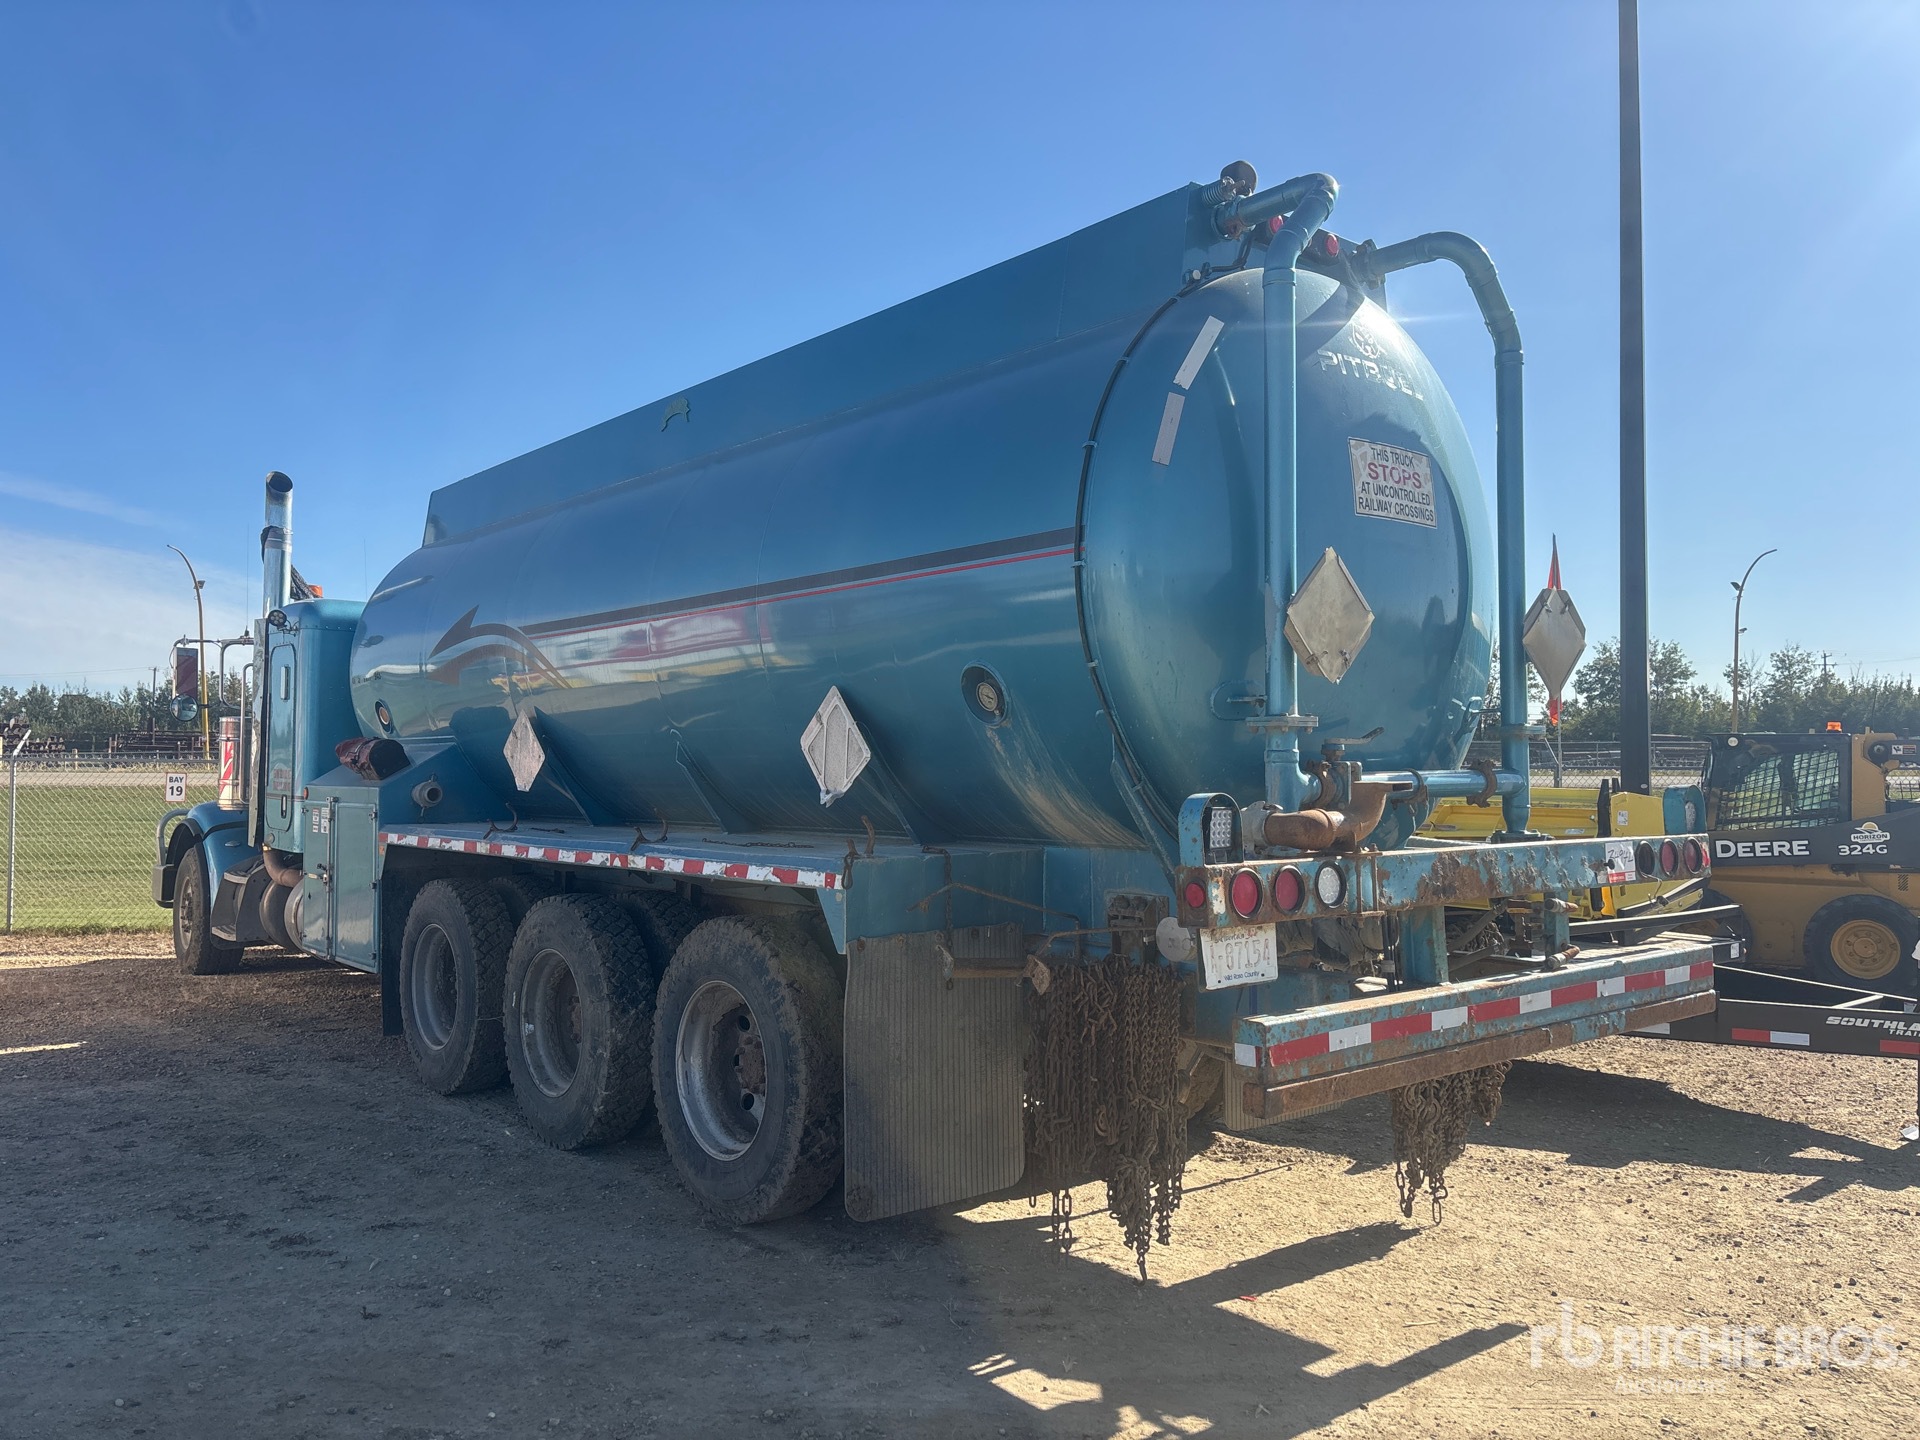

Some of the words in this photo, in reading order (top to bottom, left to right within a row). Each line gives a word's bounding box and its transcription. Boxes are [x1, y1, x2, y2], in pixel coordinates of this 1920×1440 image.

[1371, 447, 1389, 462] THIS
[1390, 451, 1415, 468] TRUCK
[1368, 462, 1422, 489] STOPS
[1361, 481, 1370, 494] AT
[1373, 483, 1430, 506] UNCONTROLLED
[1358, 497, 1392, 513] RAILWAY
[1394, 502, 1434, 522] CROSSINGS
[169, 785, 183, 796] 19
[1715, 840, 1810, 858] DEERE
[1838, 844, 1888, 856] 324G
[1889, 1029, 1920, 1037] TRAI
